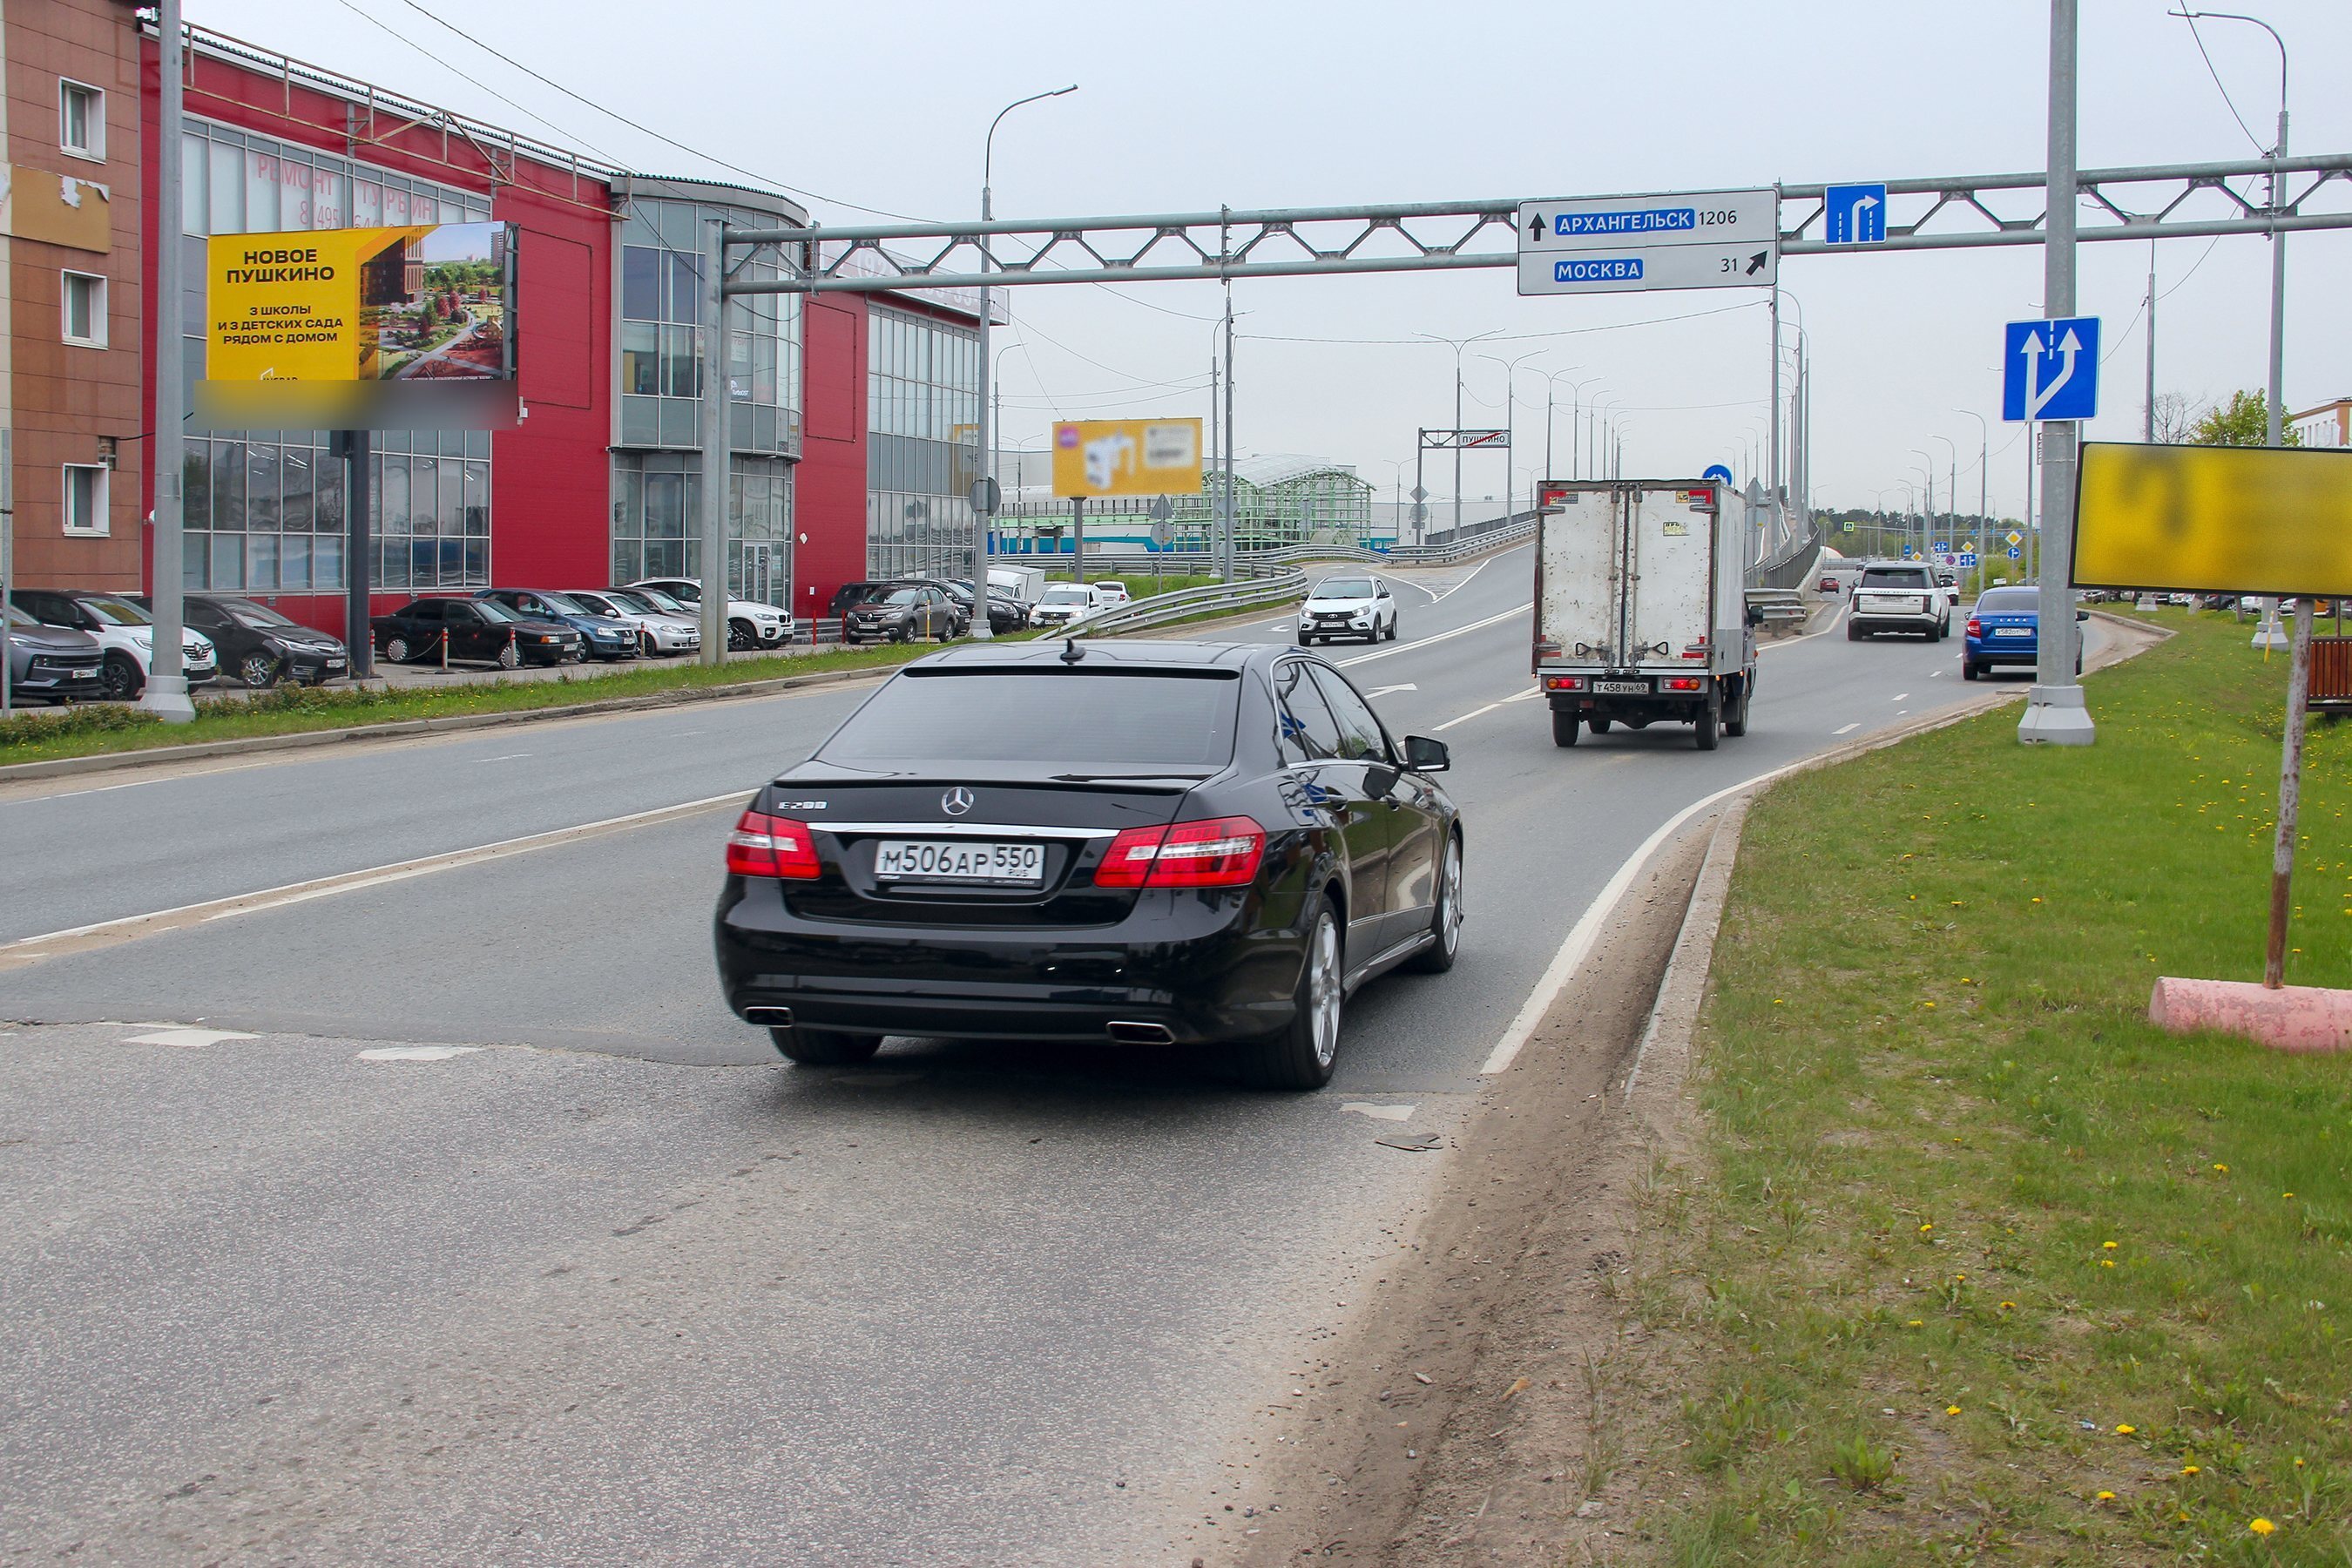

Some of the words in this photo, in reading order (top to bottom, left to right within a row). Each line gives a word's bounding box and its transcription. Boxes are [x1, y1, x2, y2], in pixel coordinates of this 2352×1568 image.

[258, 155, 335, 196] РЕМОНТ
[361, 181, 432, 220] ТУРБИН
[1558, 213, 1690, 233] АРХАНГЕЛЬСК
[1699, 210, 1737, 226] 1206
[244, 249, 317, 265] НОВОЕ
[226, 266, 335, 283] ПУШКИНО
[1558, 263, 1639, 279] МОСКВА
[1720, 258, 1737, 273] 31
[249, 307, 258, 315] 3
[260, 306, 311, 315] ШКОЛЫ
[218, 321, 227, 331] И
[230, 321, 238, 330] 3
[241, 320, 302, 331] ДЕТСКИХ
[305, 318, 343, 329] САДА
[223, 334, 272, 345] РЯДОМ
[274, 334, 283, 343] С
[286, 332, 337, 344] ДОМОМ
[1597, 683, 1634, 693] Т458УН
[778, 801, 828, 809] E200
[883, 845, 990, 874] М506АР
[994, 846, 1036, 868] 550
